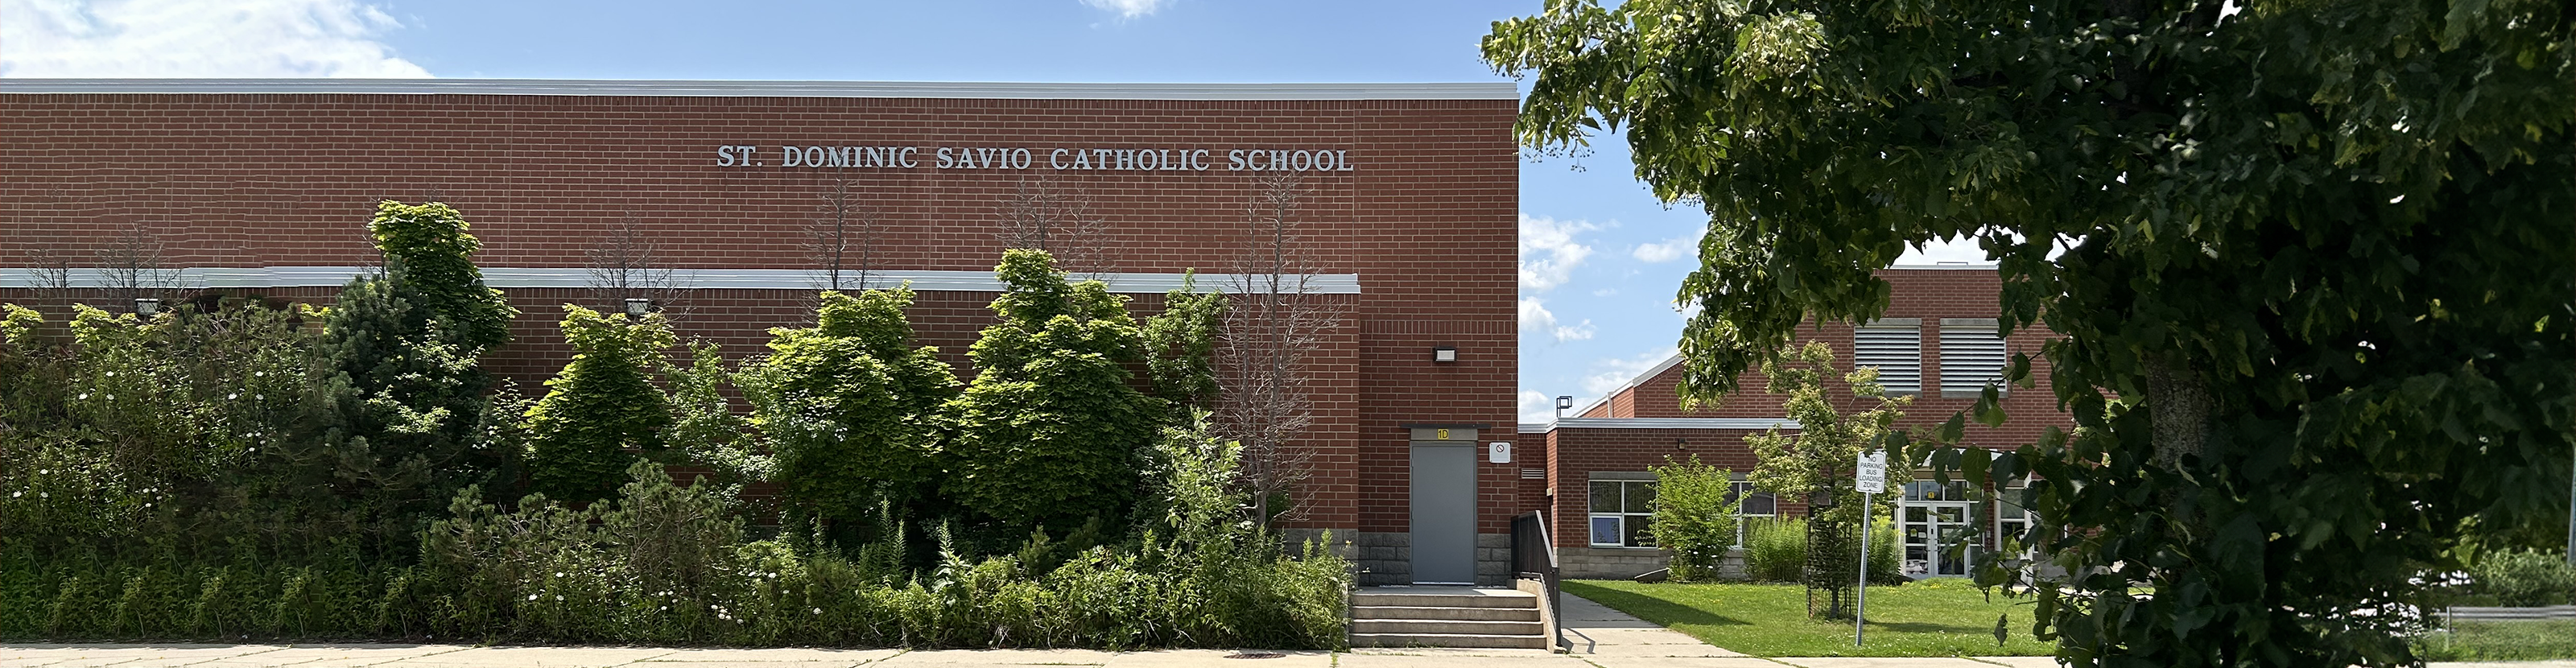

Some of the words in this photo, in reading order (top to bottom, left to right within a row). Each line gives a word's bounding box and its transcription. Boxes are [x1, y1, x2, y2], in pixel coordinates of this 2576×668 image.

[716, 145, 763, 167] ST.
[782, 146, 918, 168] DOMINIC
[936, 147, 1032, 169] SAVIO
[1050, 148, 1210, 171] CATHOLIC
[1228, 149, 1354, 171] SCHOOL
[1438, 430, 1448, 438] 1D
